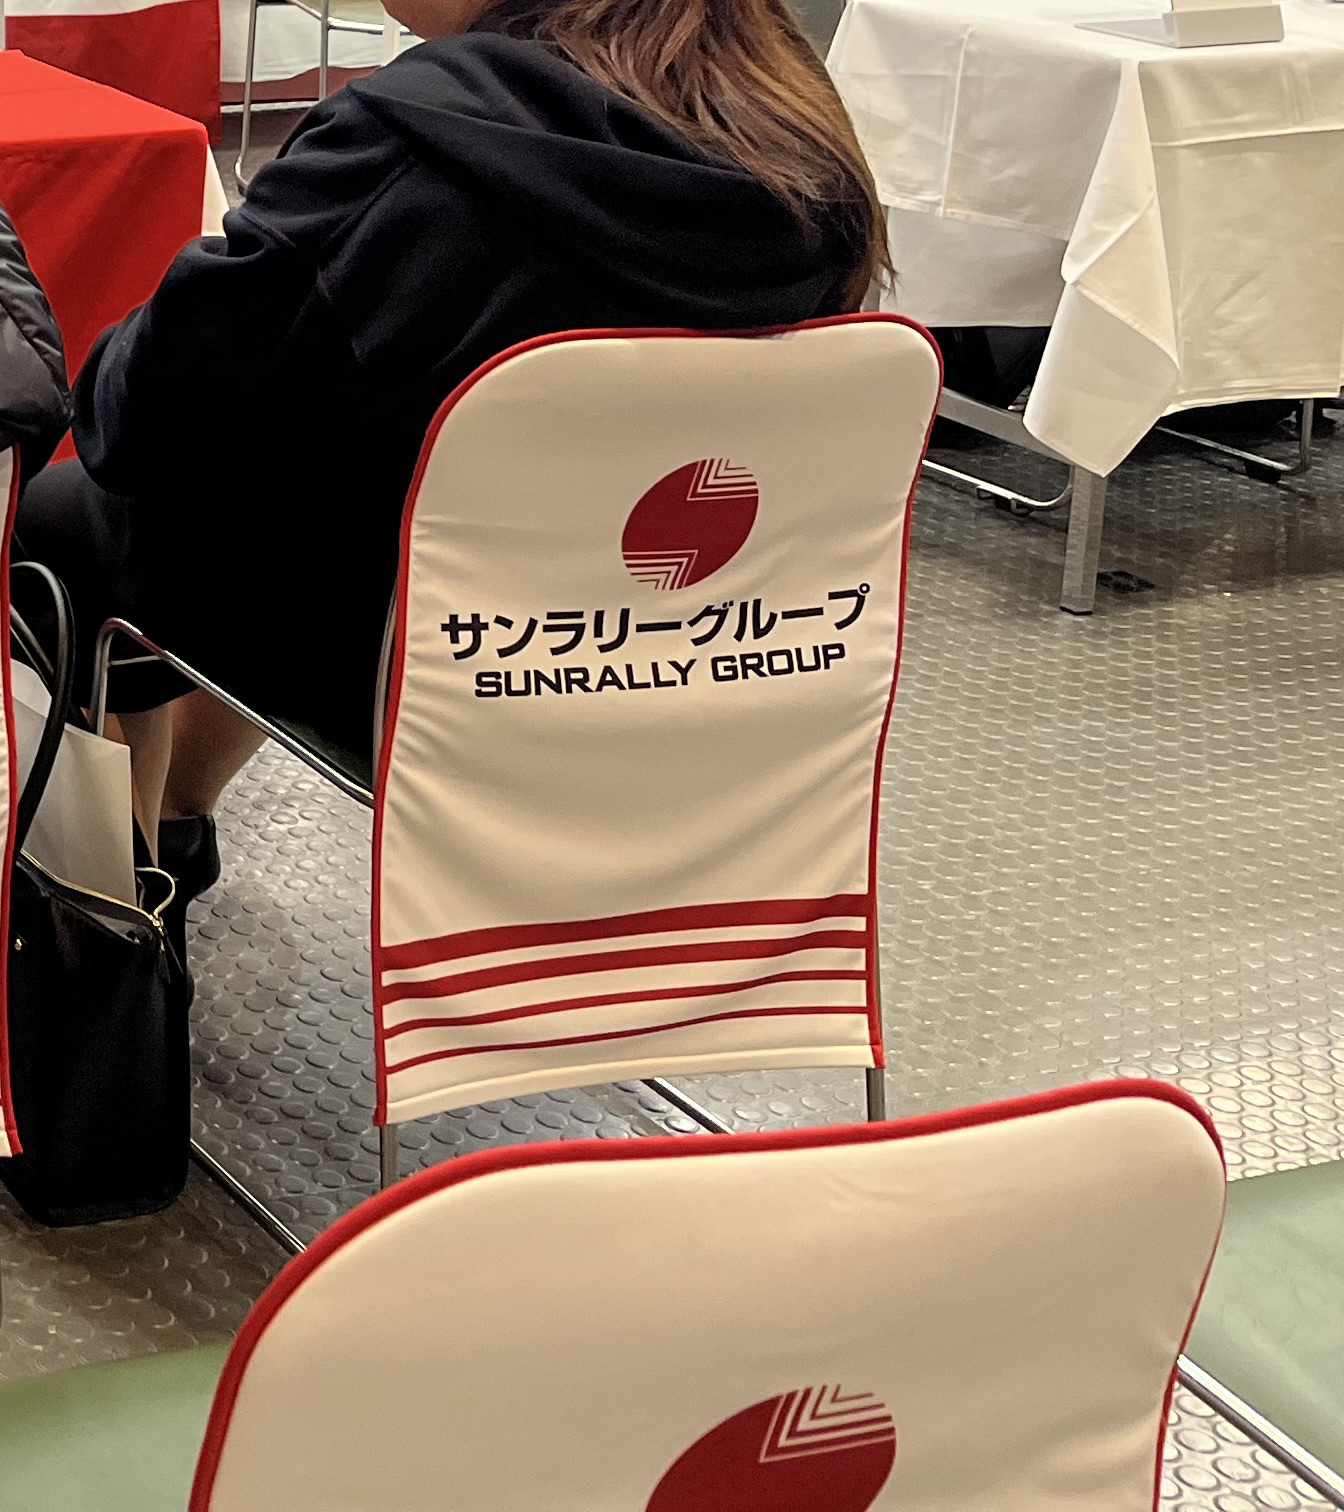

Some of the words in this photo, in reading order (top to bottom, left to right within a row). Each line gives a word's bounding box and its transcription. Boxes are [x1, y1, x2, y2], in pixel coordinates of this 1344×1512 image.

[441, 582, 870, 660] サンラリーグループ
[474, 658, 697, 698] SUNRALLY
[711, 643, 846, 683] GROUP
